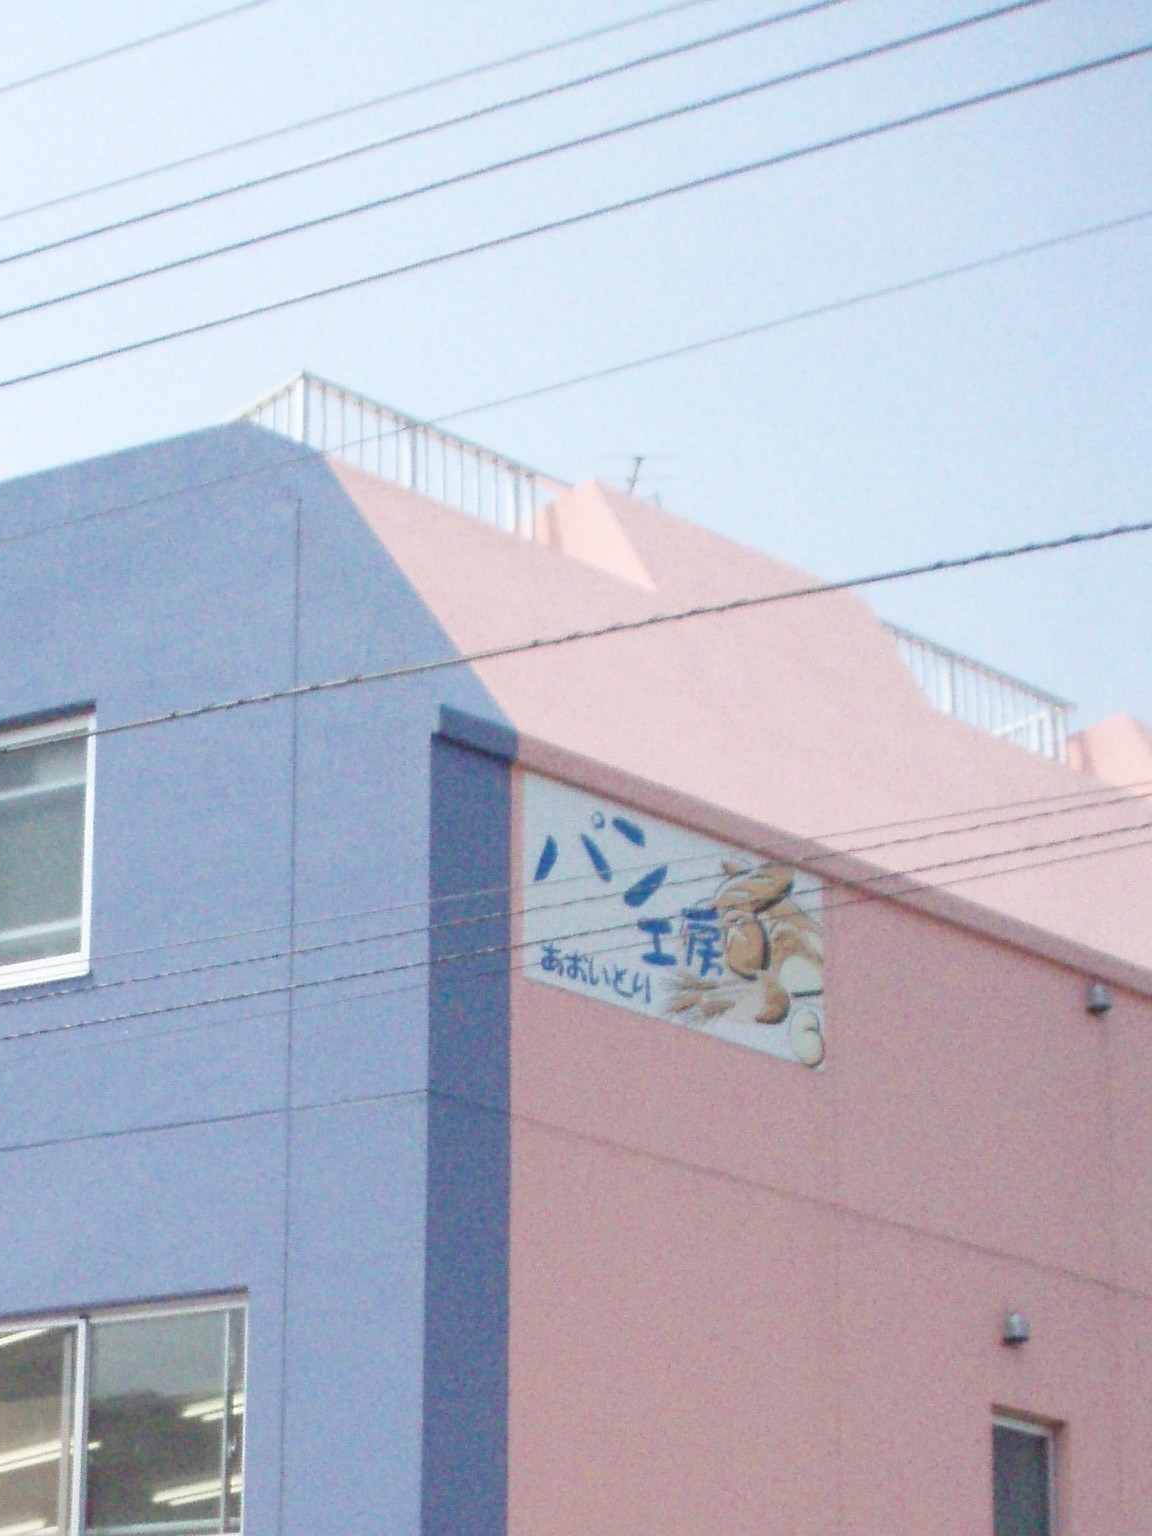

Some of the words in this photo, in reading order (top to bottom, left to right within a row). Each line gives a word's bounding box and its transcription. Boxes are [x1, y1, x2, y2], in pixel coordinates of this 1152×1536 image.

[540, 944, 651, 1004] あおいとり
